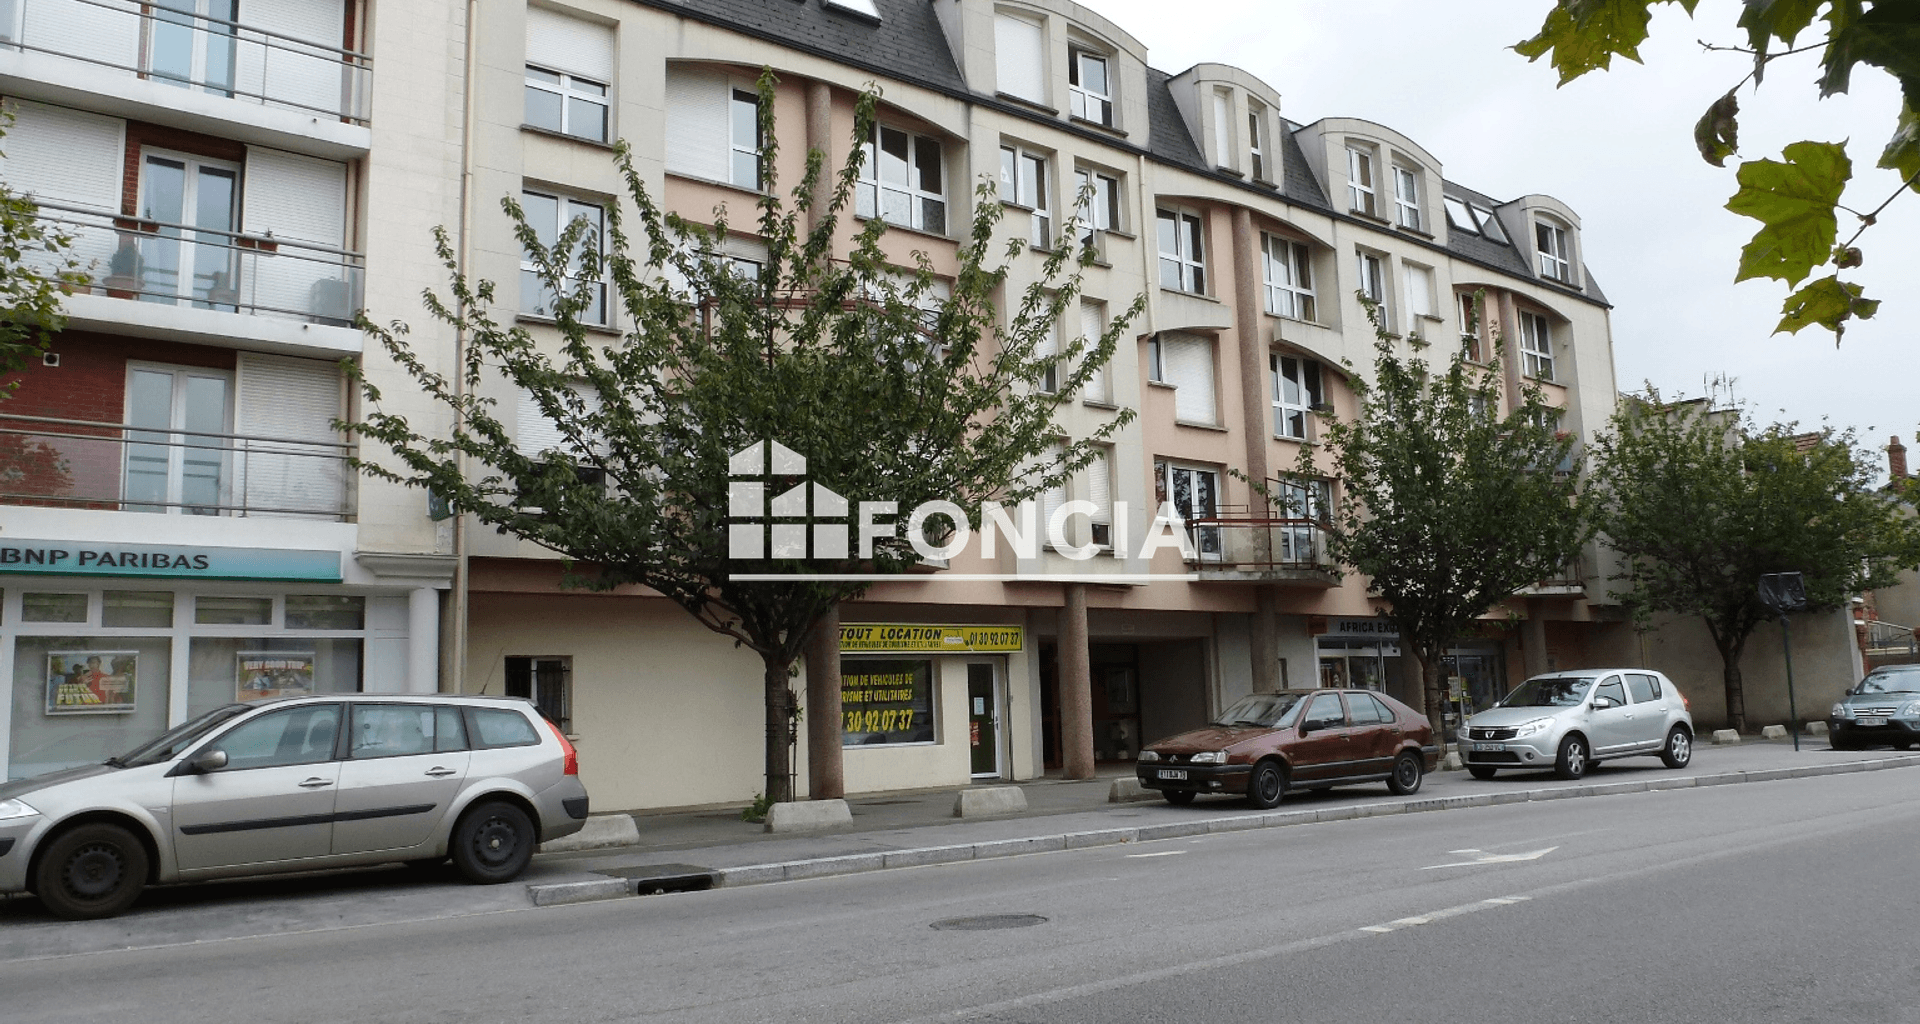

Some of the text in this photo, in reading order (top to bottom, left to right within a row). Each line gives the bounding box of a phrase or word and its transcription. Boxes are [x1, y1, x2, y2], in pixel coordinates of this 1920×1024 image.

[1, 548, 209, 569] BNP PARIBAS
[1340, 622, 1374, 632] AFRICA
[839, 628, 873, 640] TOUT
[880, 628, 942, 640] LOCATION
[979, 632, 988, 645] 30
[990, 632, 998, 645] 92
[1000, 632, 1009, 645] 07
[1011, 632, 1019, 645] 37
[841, 673, 914, 687] TION DE VEHICULES DE
[842, 688, 913, 702] RISME ET UTILITAIRES
[847, 710, 861, 733] 30
[865, 709, 879, 733] 92
[881, 709, 897, 733] 07
[898, 709, 913, 731] 37
